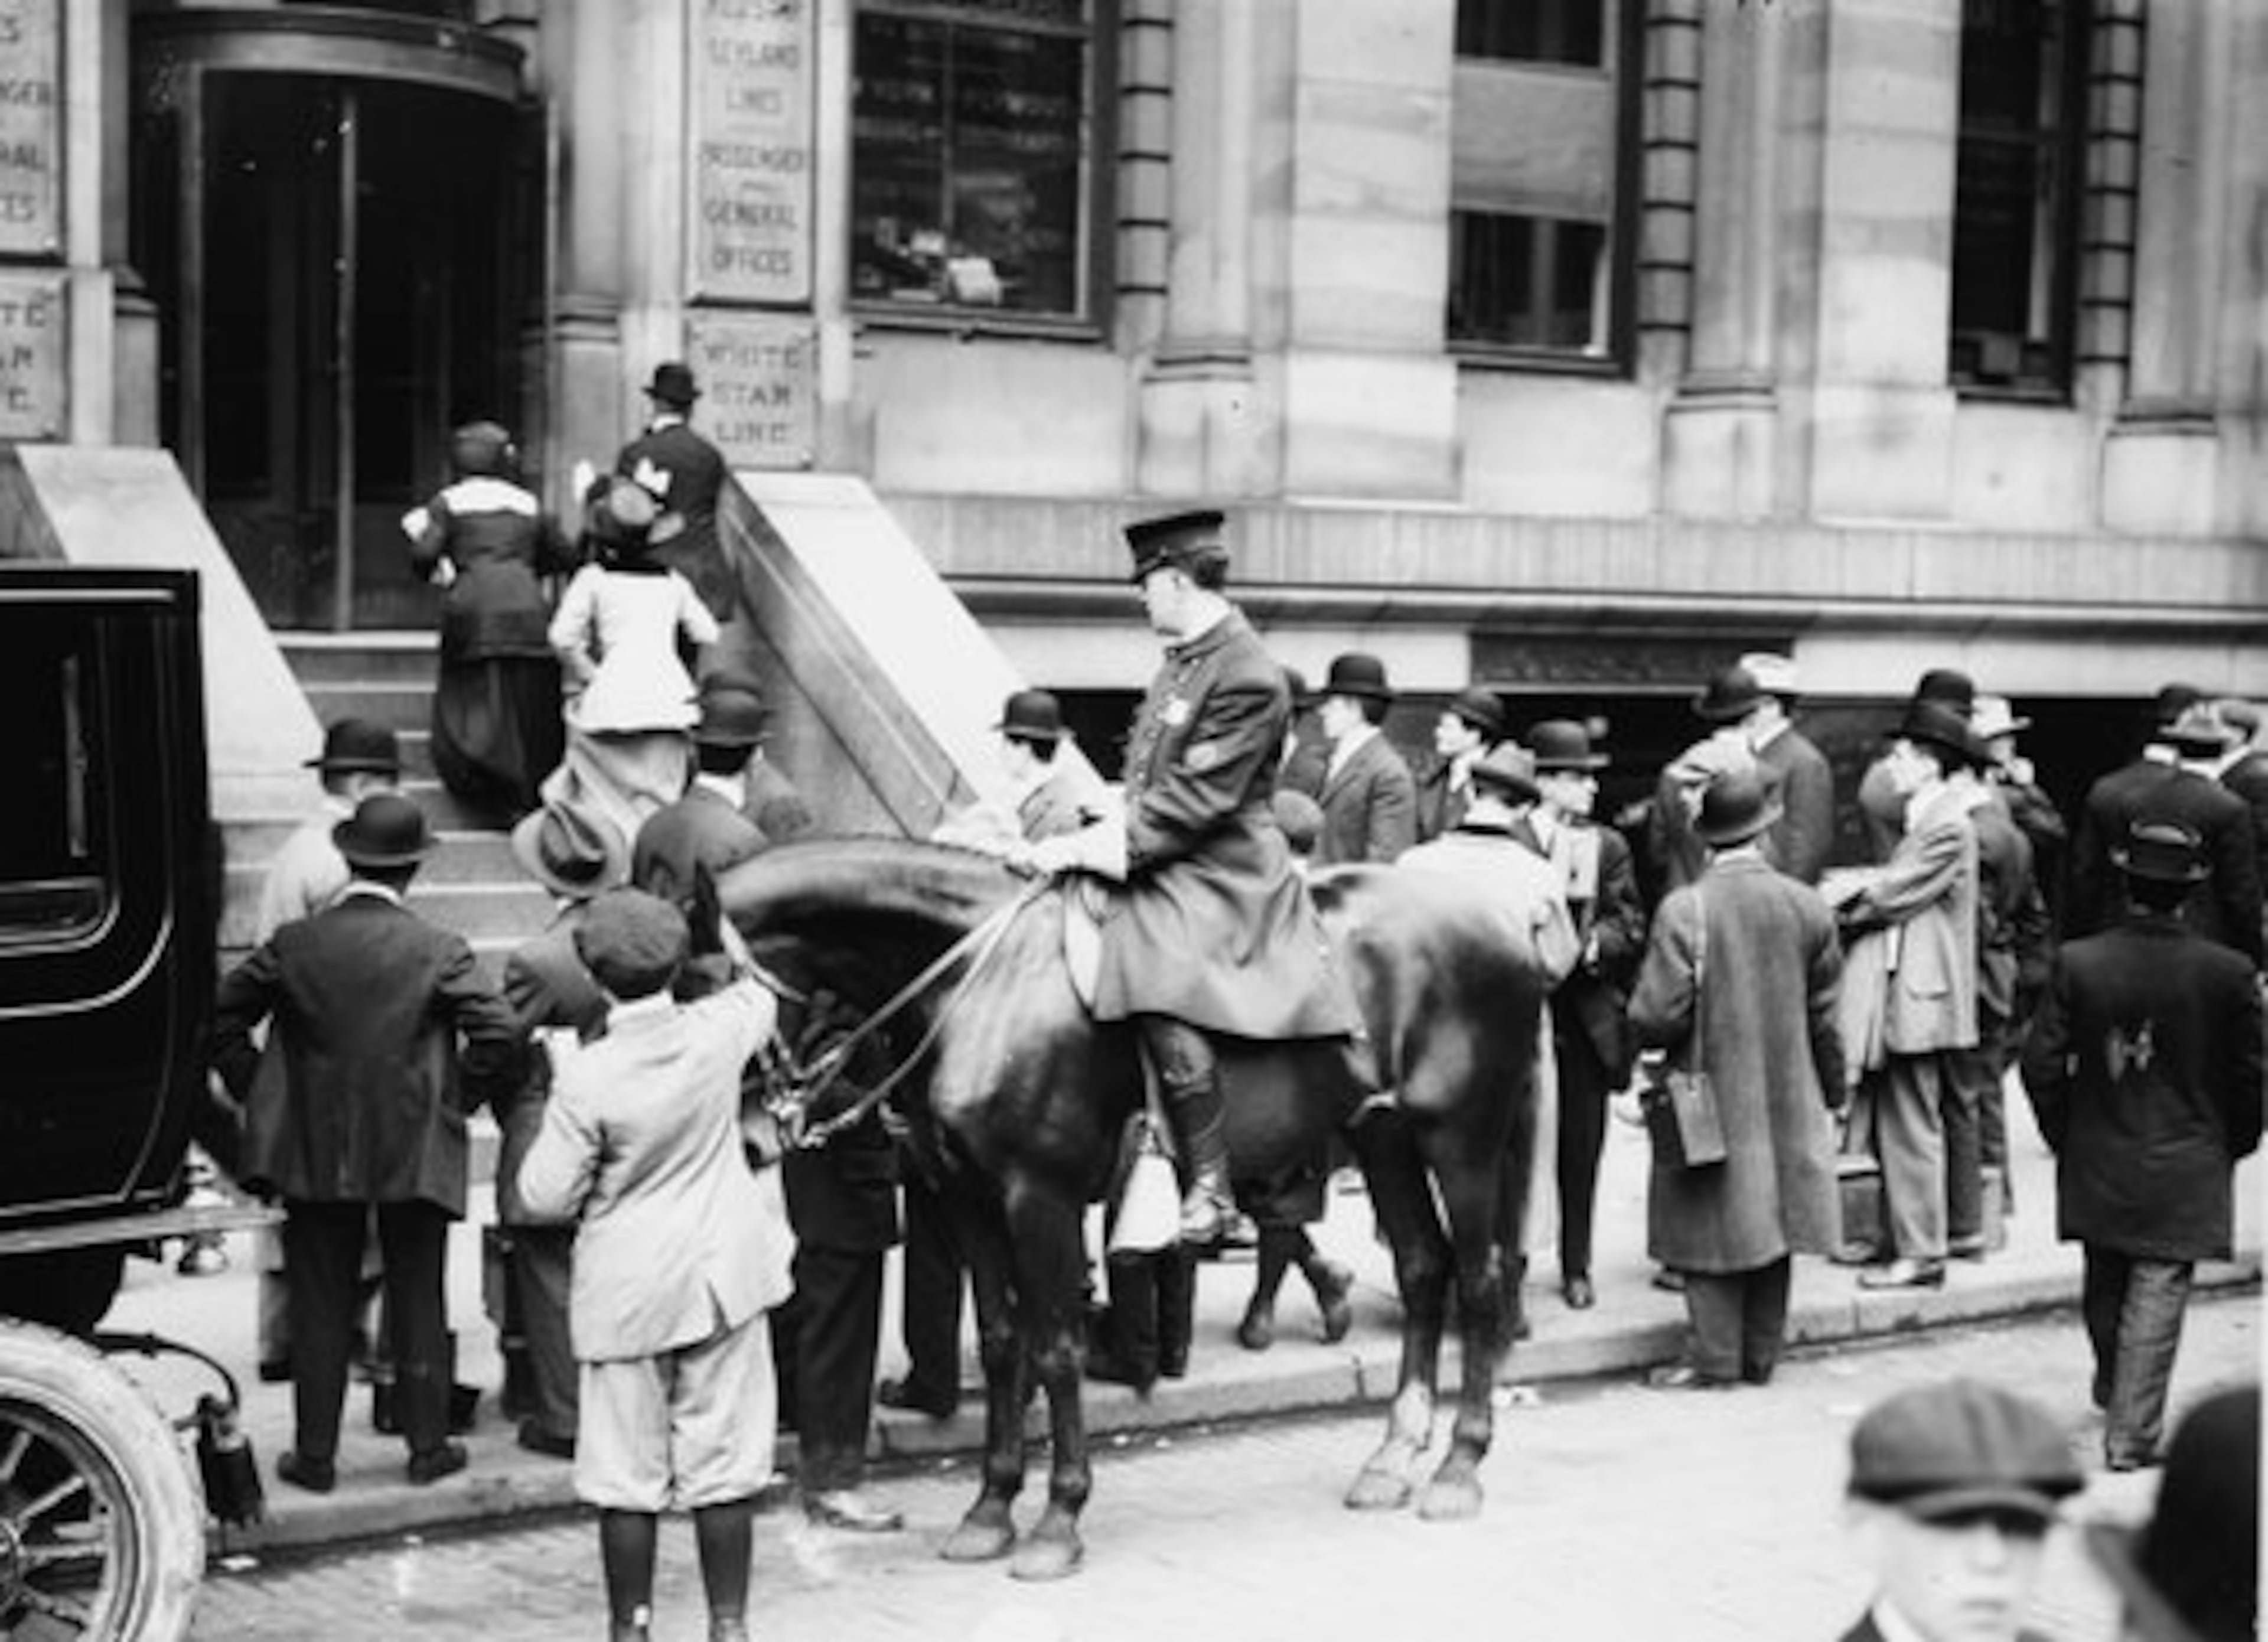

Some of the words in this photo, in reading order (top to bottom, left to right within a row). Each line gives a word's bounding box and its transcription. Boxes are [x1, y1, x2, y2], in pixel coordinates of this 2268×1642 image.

[703, 196, 799, 231] GENERAL
[712, 244, 792, 275] OFFICES
[703, 345, 800, 369] WHITE
[712, 382, 792, 406] STAR
[715, 421, 789, 443] LINE
